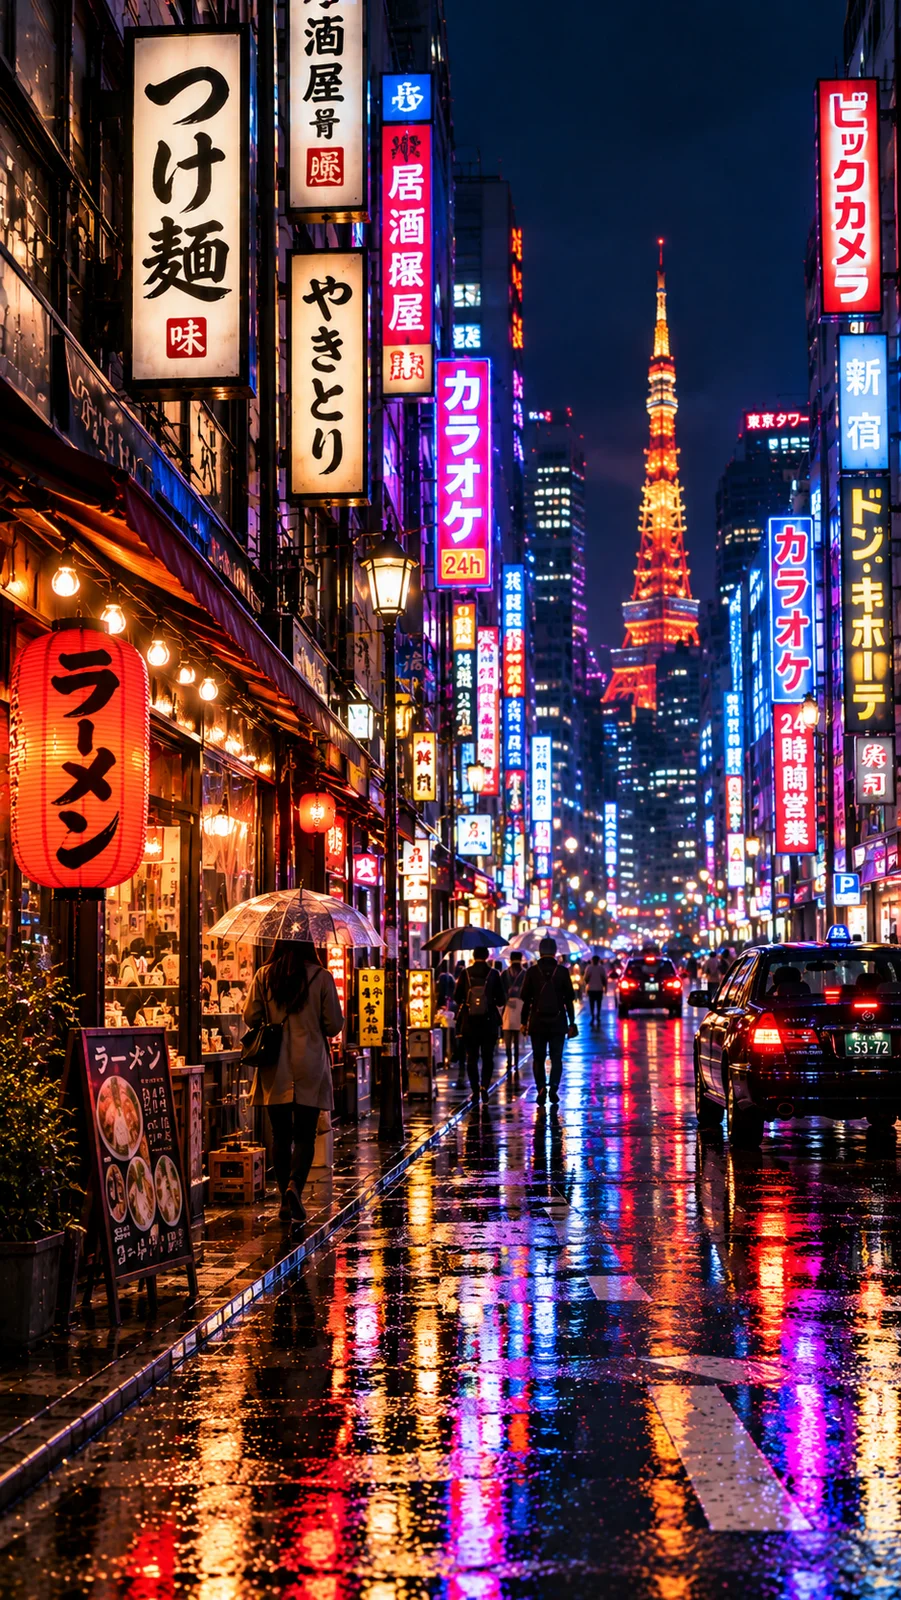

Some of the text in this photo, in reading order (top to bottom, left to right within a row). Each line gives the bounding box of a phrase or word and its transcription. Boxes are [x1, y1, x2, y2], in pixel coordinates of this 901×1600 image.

[142, 66, 233, 302] つけ麺
[829, 92, 869, 304] ビックカメラ
[170, 321, 206, 355] 味
[302, 275, 352, 475] やきとり
[444, 370, 483, 543] カラオケ
[747, 412, 810, 429] 東京タワー
[846, 358, 881, 451] 新宿
[444, 555, 481, 575] 24h
[775, 525, 810, 693] カラオケ
[51, 649, 120, 870] ラーメン
[840, 876, 855, 893] P
[94, 1042, 161, 1075] ラーメン
